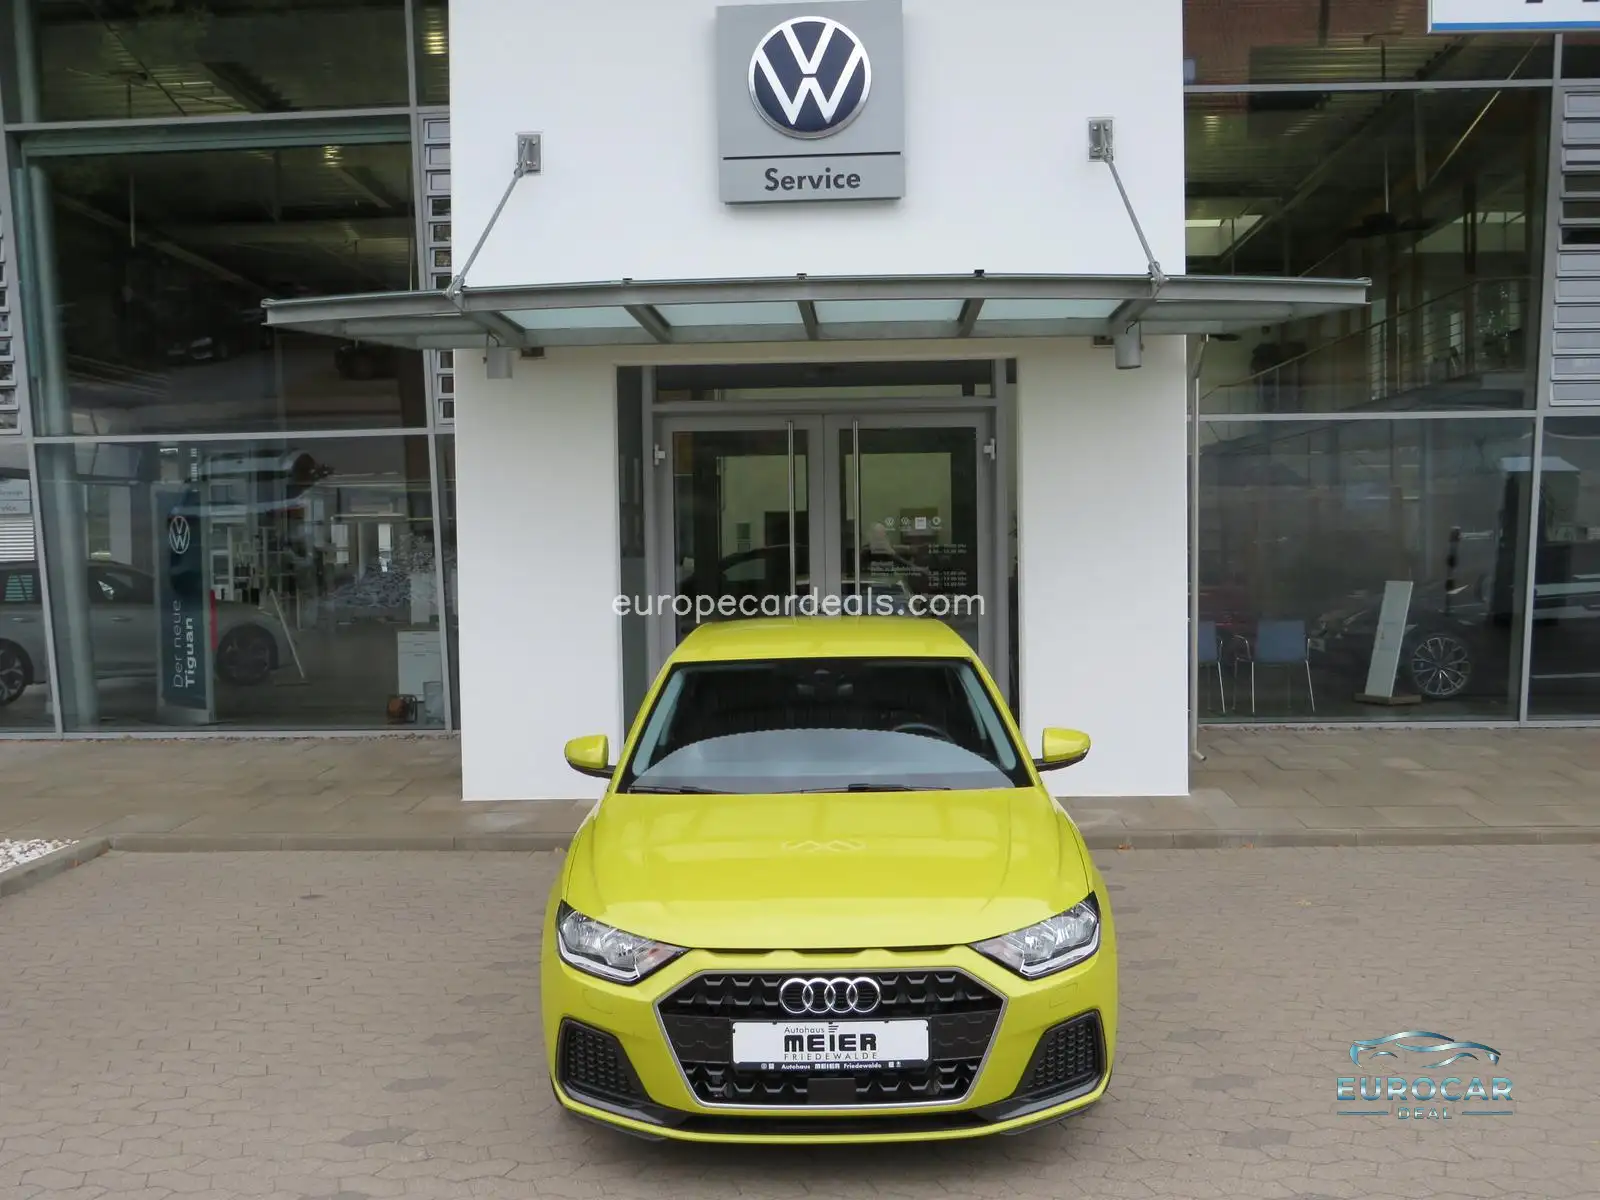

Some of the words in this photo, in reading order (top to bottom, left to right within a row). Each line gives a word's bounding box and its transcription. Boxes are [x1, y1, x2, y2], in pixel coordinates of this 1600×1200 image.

[764, 167, 861, 191] Service
[173, 599, 182, 648] neue
[184, 617, 197, 688] Tiguan
[173, 654, 183, 688] Der
[784, 1026, 825, 1034] Autohaus
[784, 1033, 877, 1052] MEIER
[784, 1052, 877, 1061] FRIEDEWALDE
